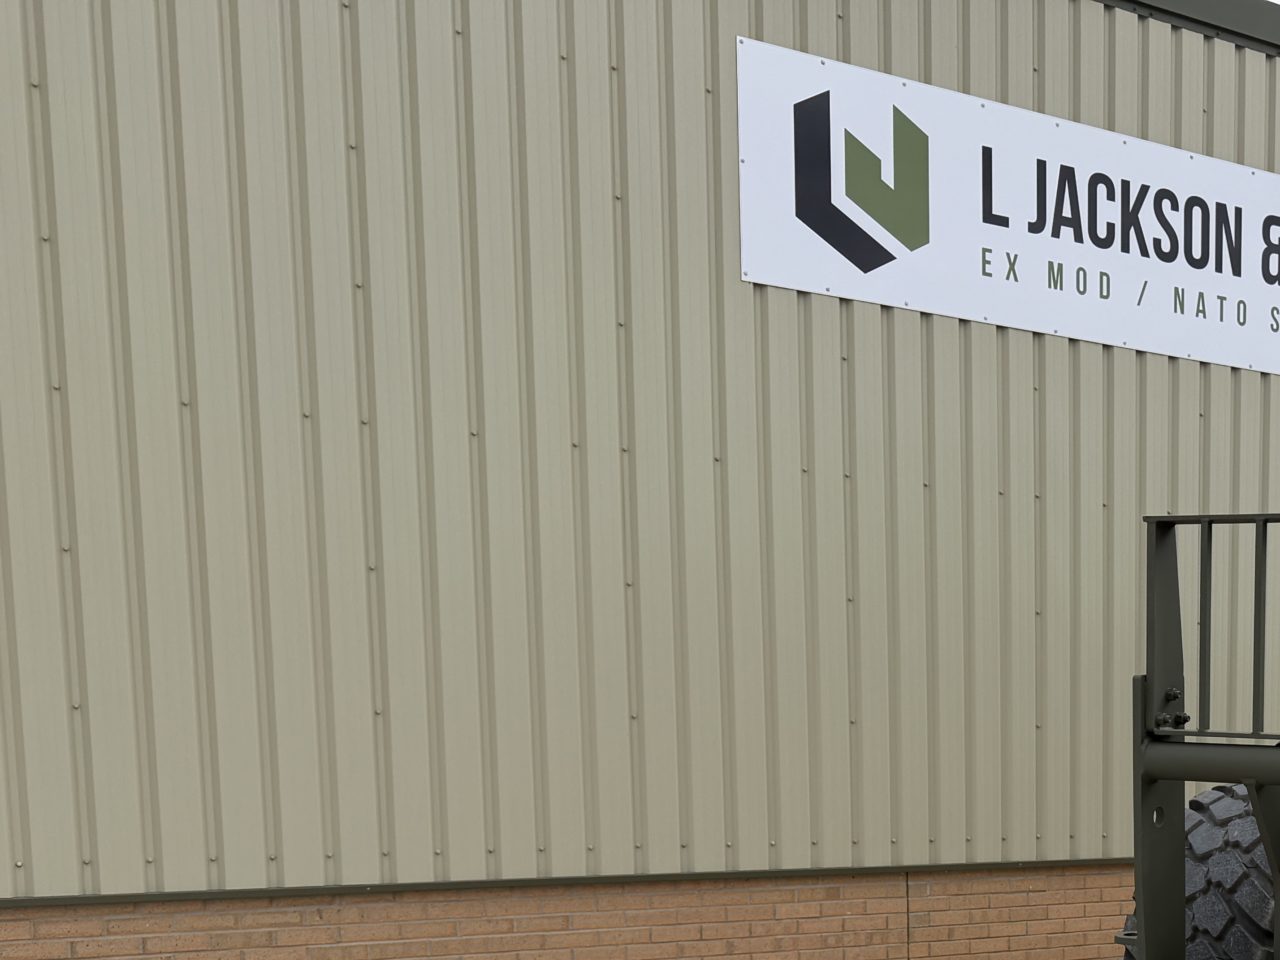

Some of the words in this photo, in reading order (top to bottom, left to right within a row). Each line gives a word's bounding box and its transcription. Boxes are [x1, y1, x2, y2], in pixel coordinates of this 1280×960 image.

[981, 145, 1010, 228] L
[1027, 158, 1243, 279] JACKSON
[981, 247, 1019, 283] EX
[1047, 260, 1111, 300] MOD
[1136, 280, 1148, 307] /
[1173, 286, 1247, 327] NATO
